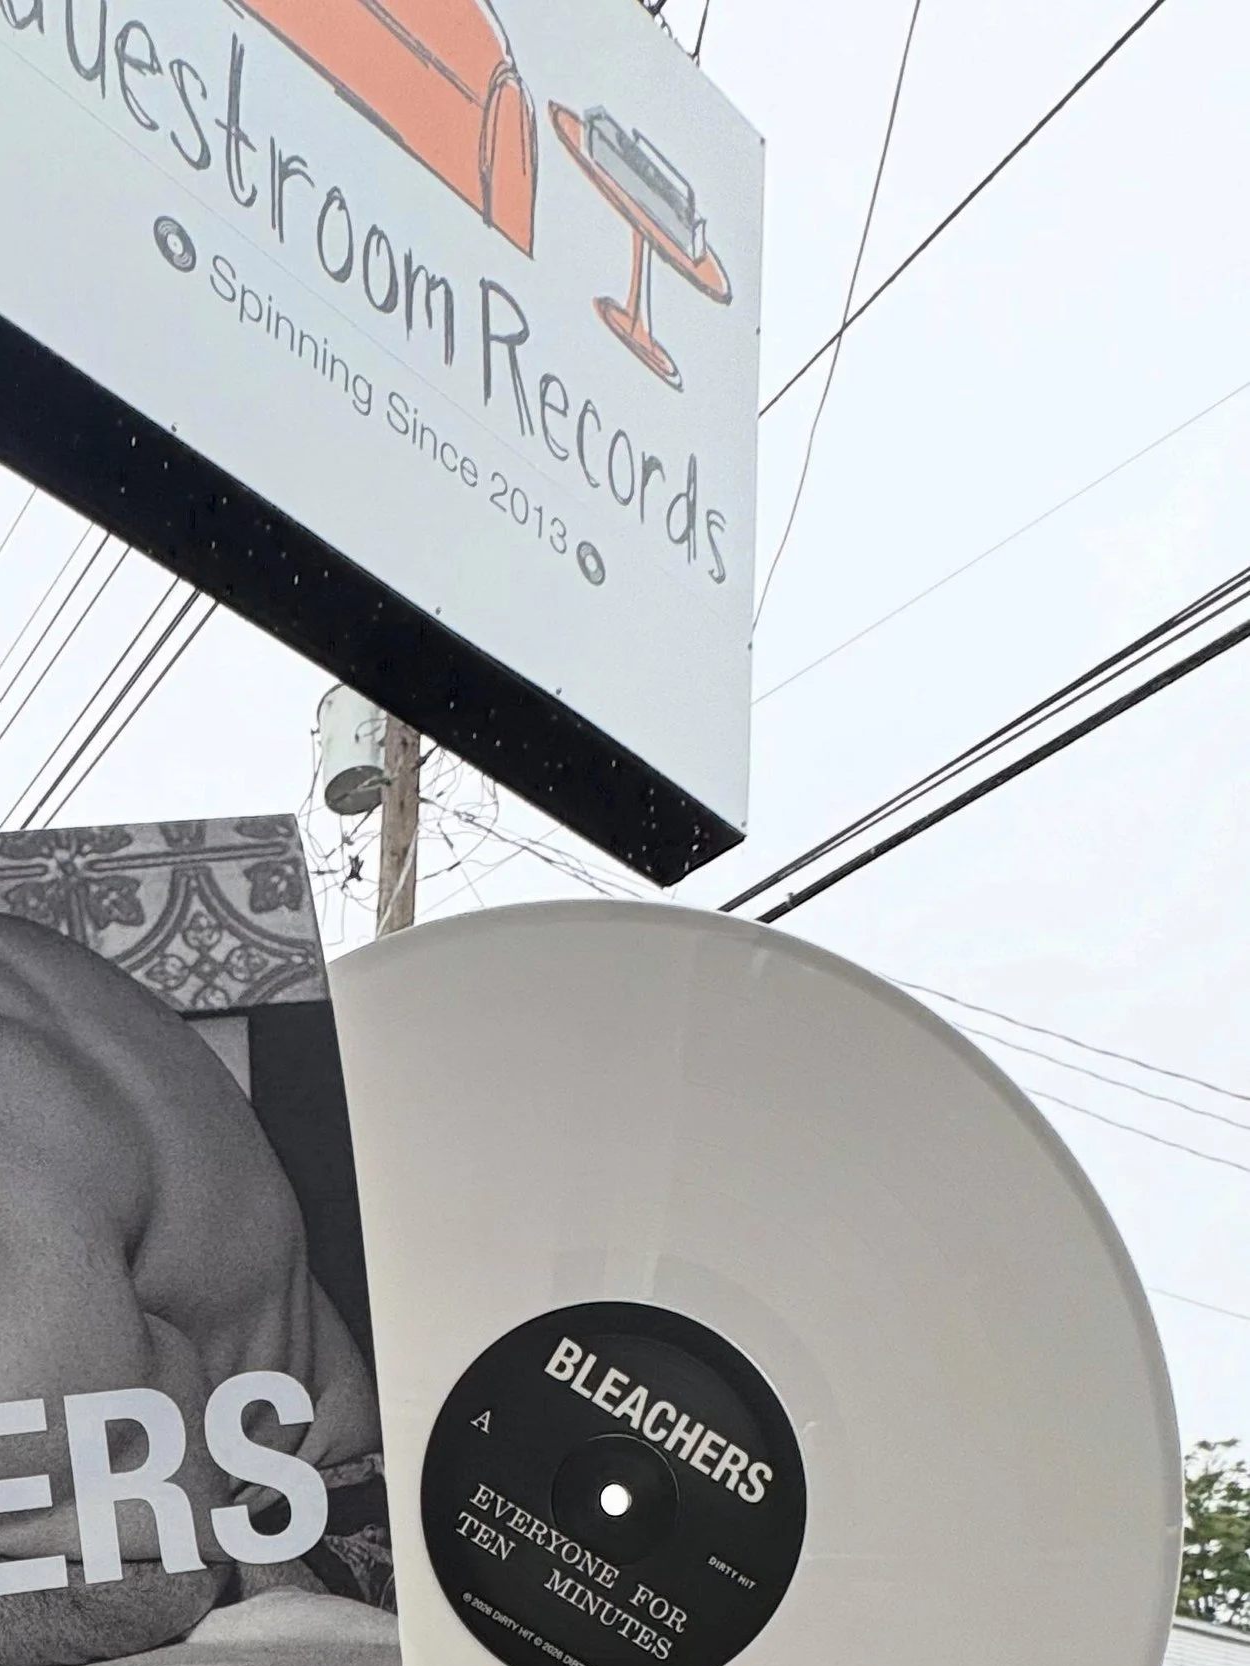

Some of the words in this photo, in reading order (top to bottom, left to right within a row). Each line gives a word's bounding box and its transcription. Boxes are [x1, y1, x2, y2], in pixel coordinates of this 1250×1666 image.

[0, 0, 454, 366] uestroom
[479, 277, 726, 585] Records
[210, 255, 373, 416] Spinning
[387, 391, 478, 488] Since
[489, 472, 567, 555] 2013
[470, 1410, 492, 1434] A
[544, 1336, 773, 1504] BLEACHERS
[455, 1511, 517, 1562] TEN
[543, 1568, 673, 1661] MINUTES
[469, 1483, 620, 1589] EVERYONE
[628, 1583, 689, 1635] FOR
[492, 1609, 519, 1632] DIRTY
[517, 1625, 536, 1643] HIT
[707, 1555, 739, 1579] DIRTY
[737, 1574, 757, 1590] HIT
